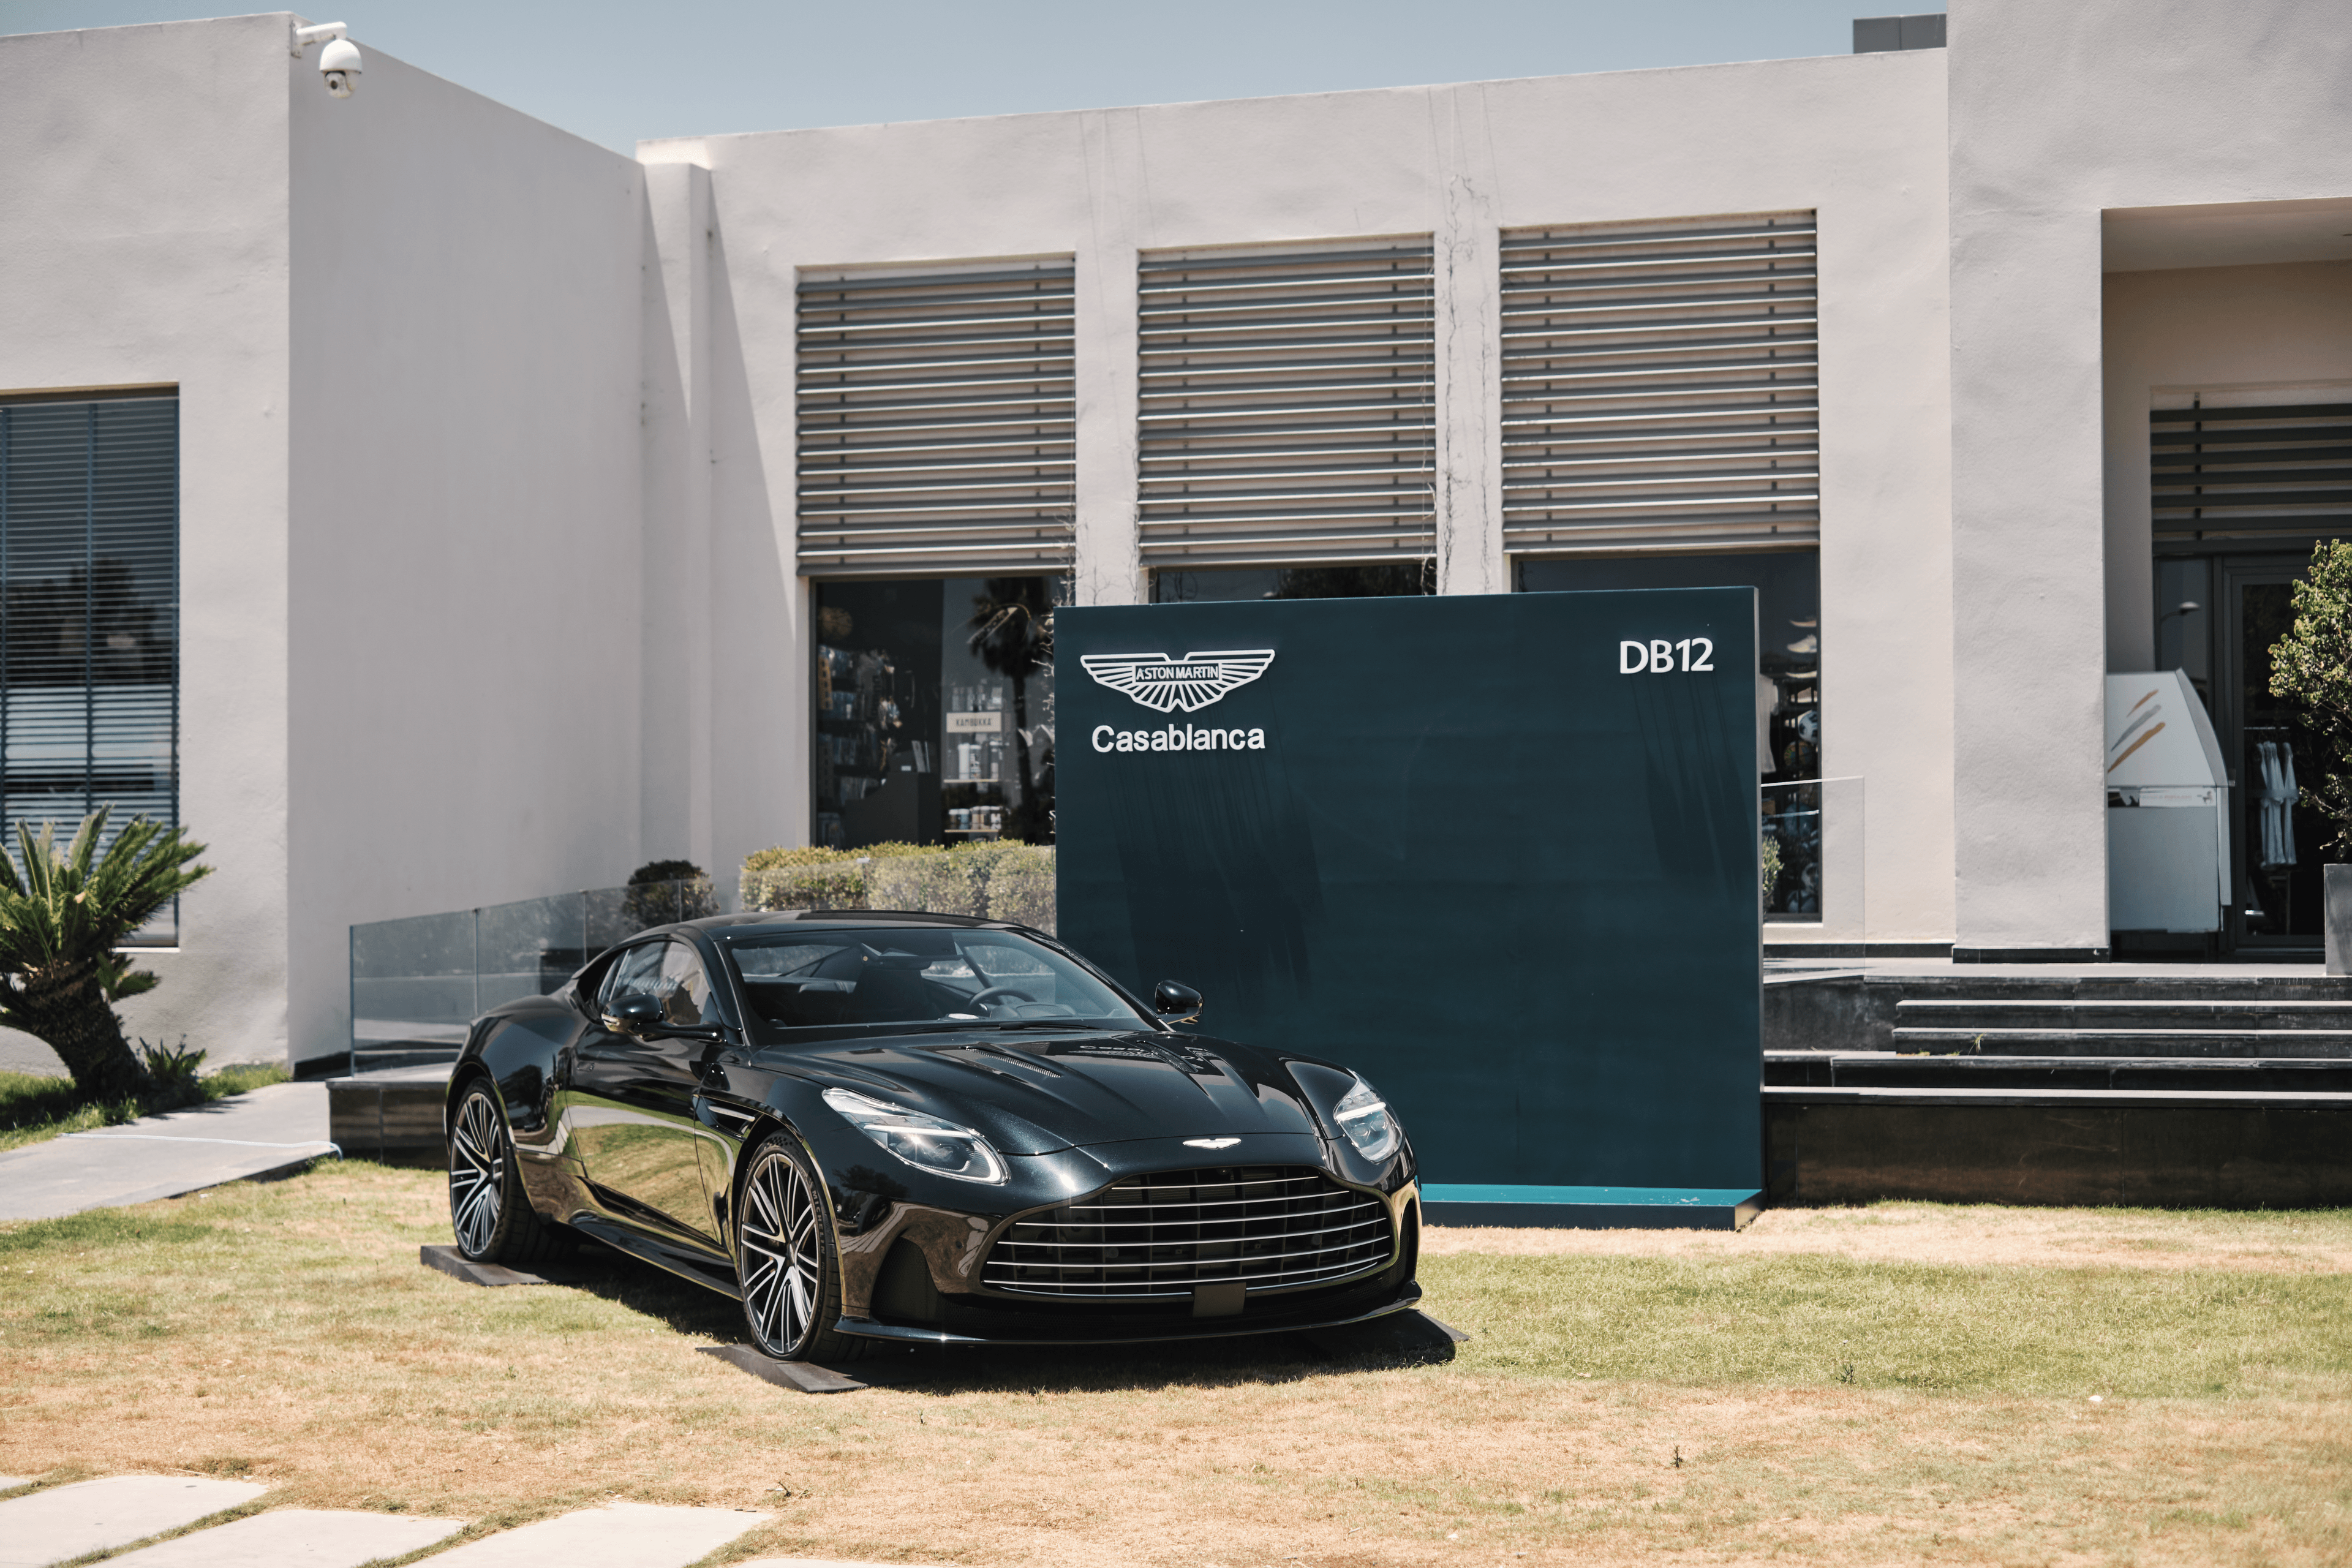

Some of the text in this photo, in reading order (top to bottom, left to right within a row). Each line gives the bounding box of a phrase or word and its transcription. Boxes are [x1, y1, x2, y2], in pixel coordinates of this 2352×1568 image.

[1620, 637, 1714, 674] DB12
[1136, 666, 1219, 680] ASTON MARTIN
[1092, 723, 1265, 753] Casablanca
[812, 1189, 826, 1254] MICHELIN
